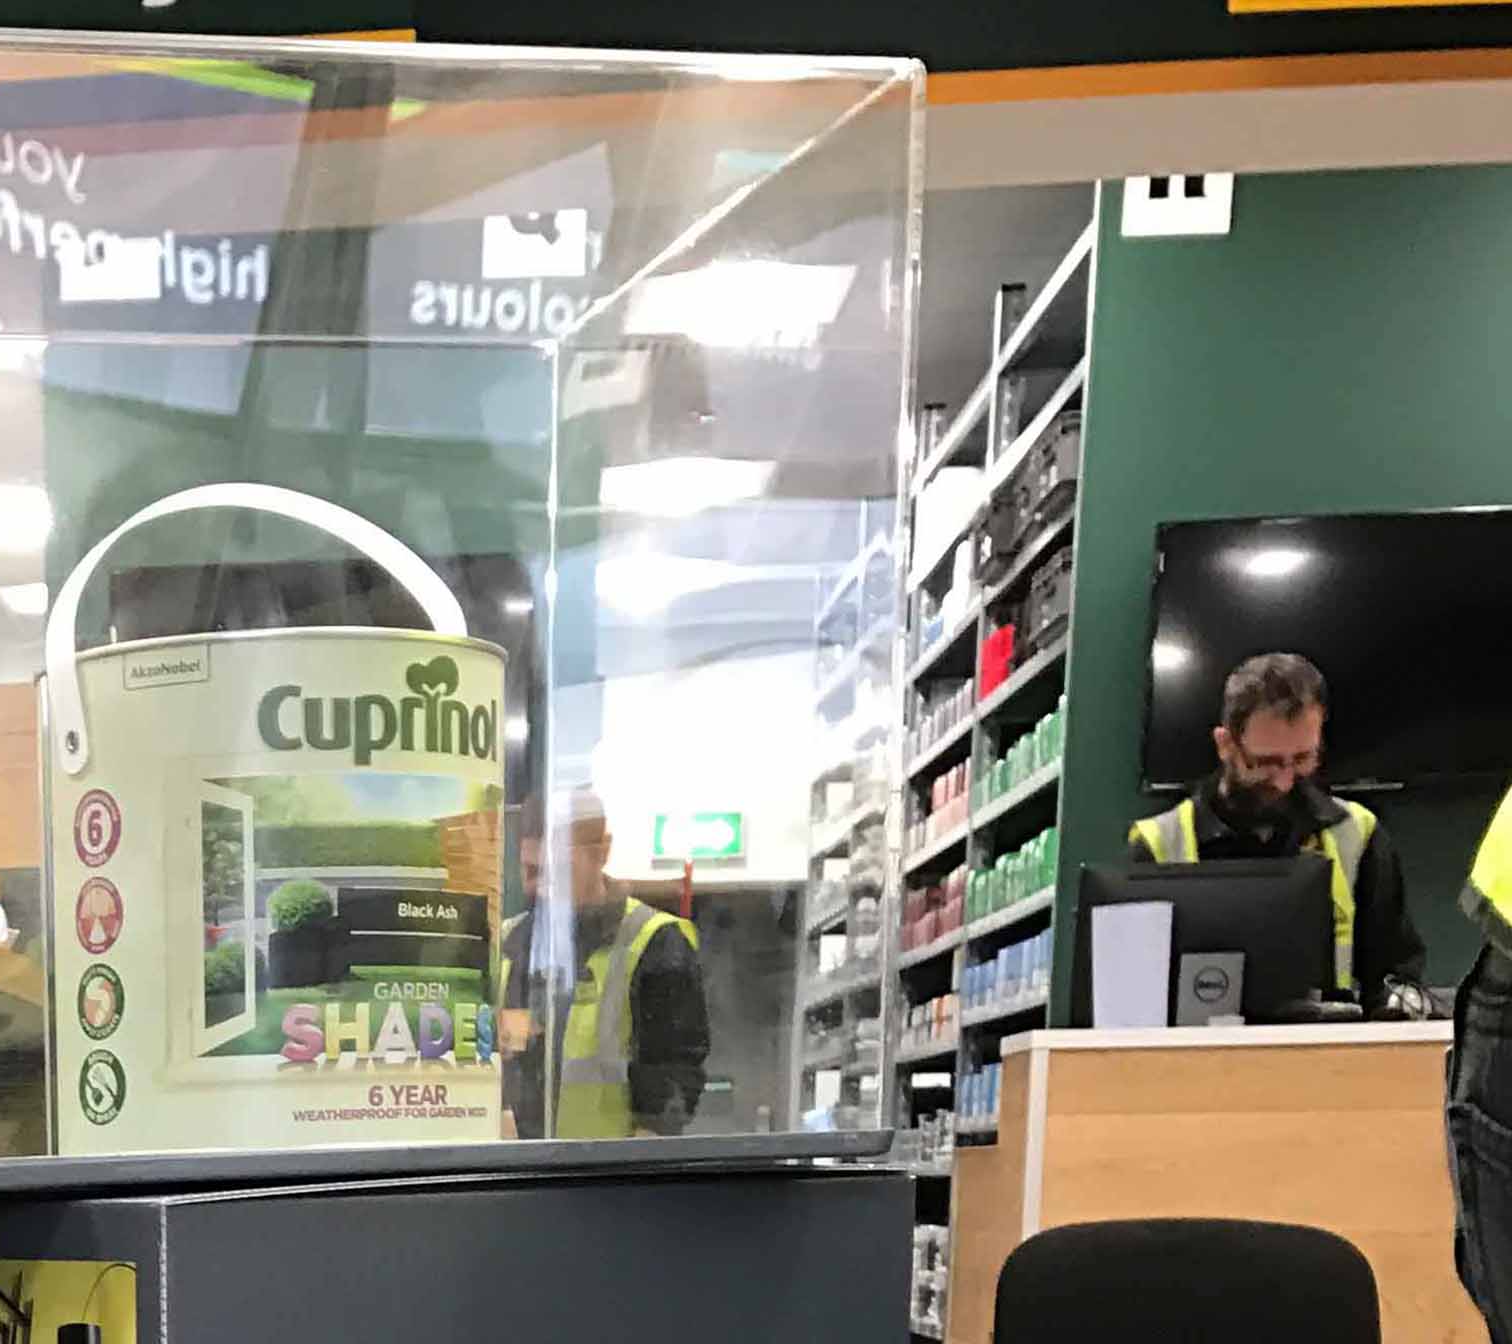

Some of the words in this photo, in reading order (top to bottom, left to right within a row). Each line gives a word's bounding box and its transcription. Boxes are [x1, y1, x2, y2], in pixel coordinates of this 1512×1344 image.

[257, 656, 497, 766] Cuprinol
[398, 902, 434, 919] Black
[436, 903, 458, 919] Ash
[374, 982, 450, 1000] GARDEN
[280, 1002, 493, 1062] SHADES
[368, 1085, 383, 1106] 6
[390, 1085, 448, 1105] YEAR
[292, 1107, 403, 1122] WEATHERPROOF
[404, 1107, 428, 1119] FOR
